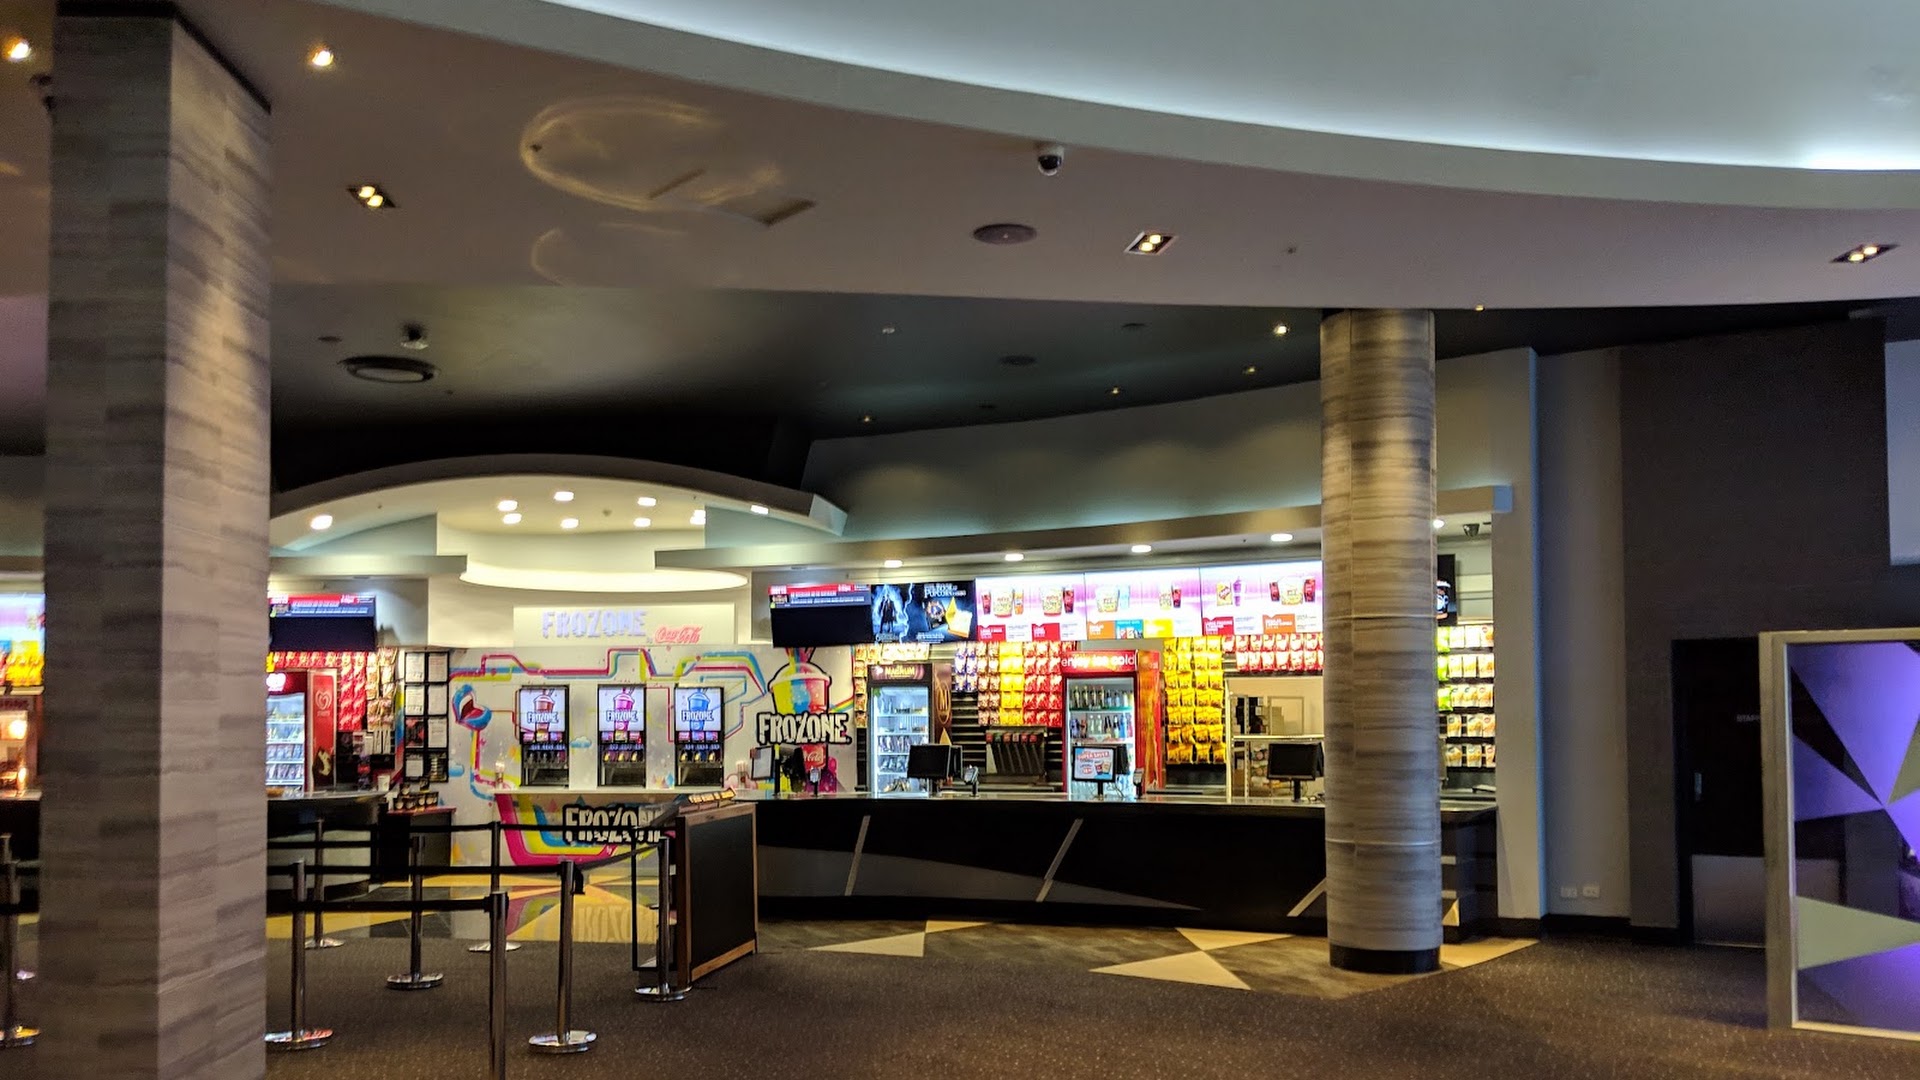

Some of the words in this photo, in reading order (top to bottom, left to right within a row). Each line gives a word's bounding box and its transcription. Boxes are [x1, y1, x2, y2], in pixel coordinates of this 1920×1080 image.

[542, 609, 647, 638] FROZONE
[654, 626, 704, 644] Coca-Cola
[1110, 654, 1135, 665] cold
[527, 711, 559, 724] FROZONE
[606, 710, 638, 723] FROZONE
[681, 710, 714, 722] FROZONE
[758, 711, 849, 745] FROZONE
